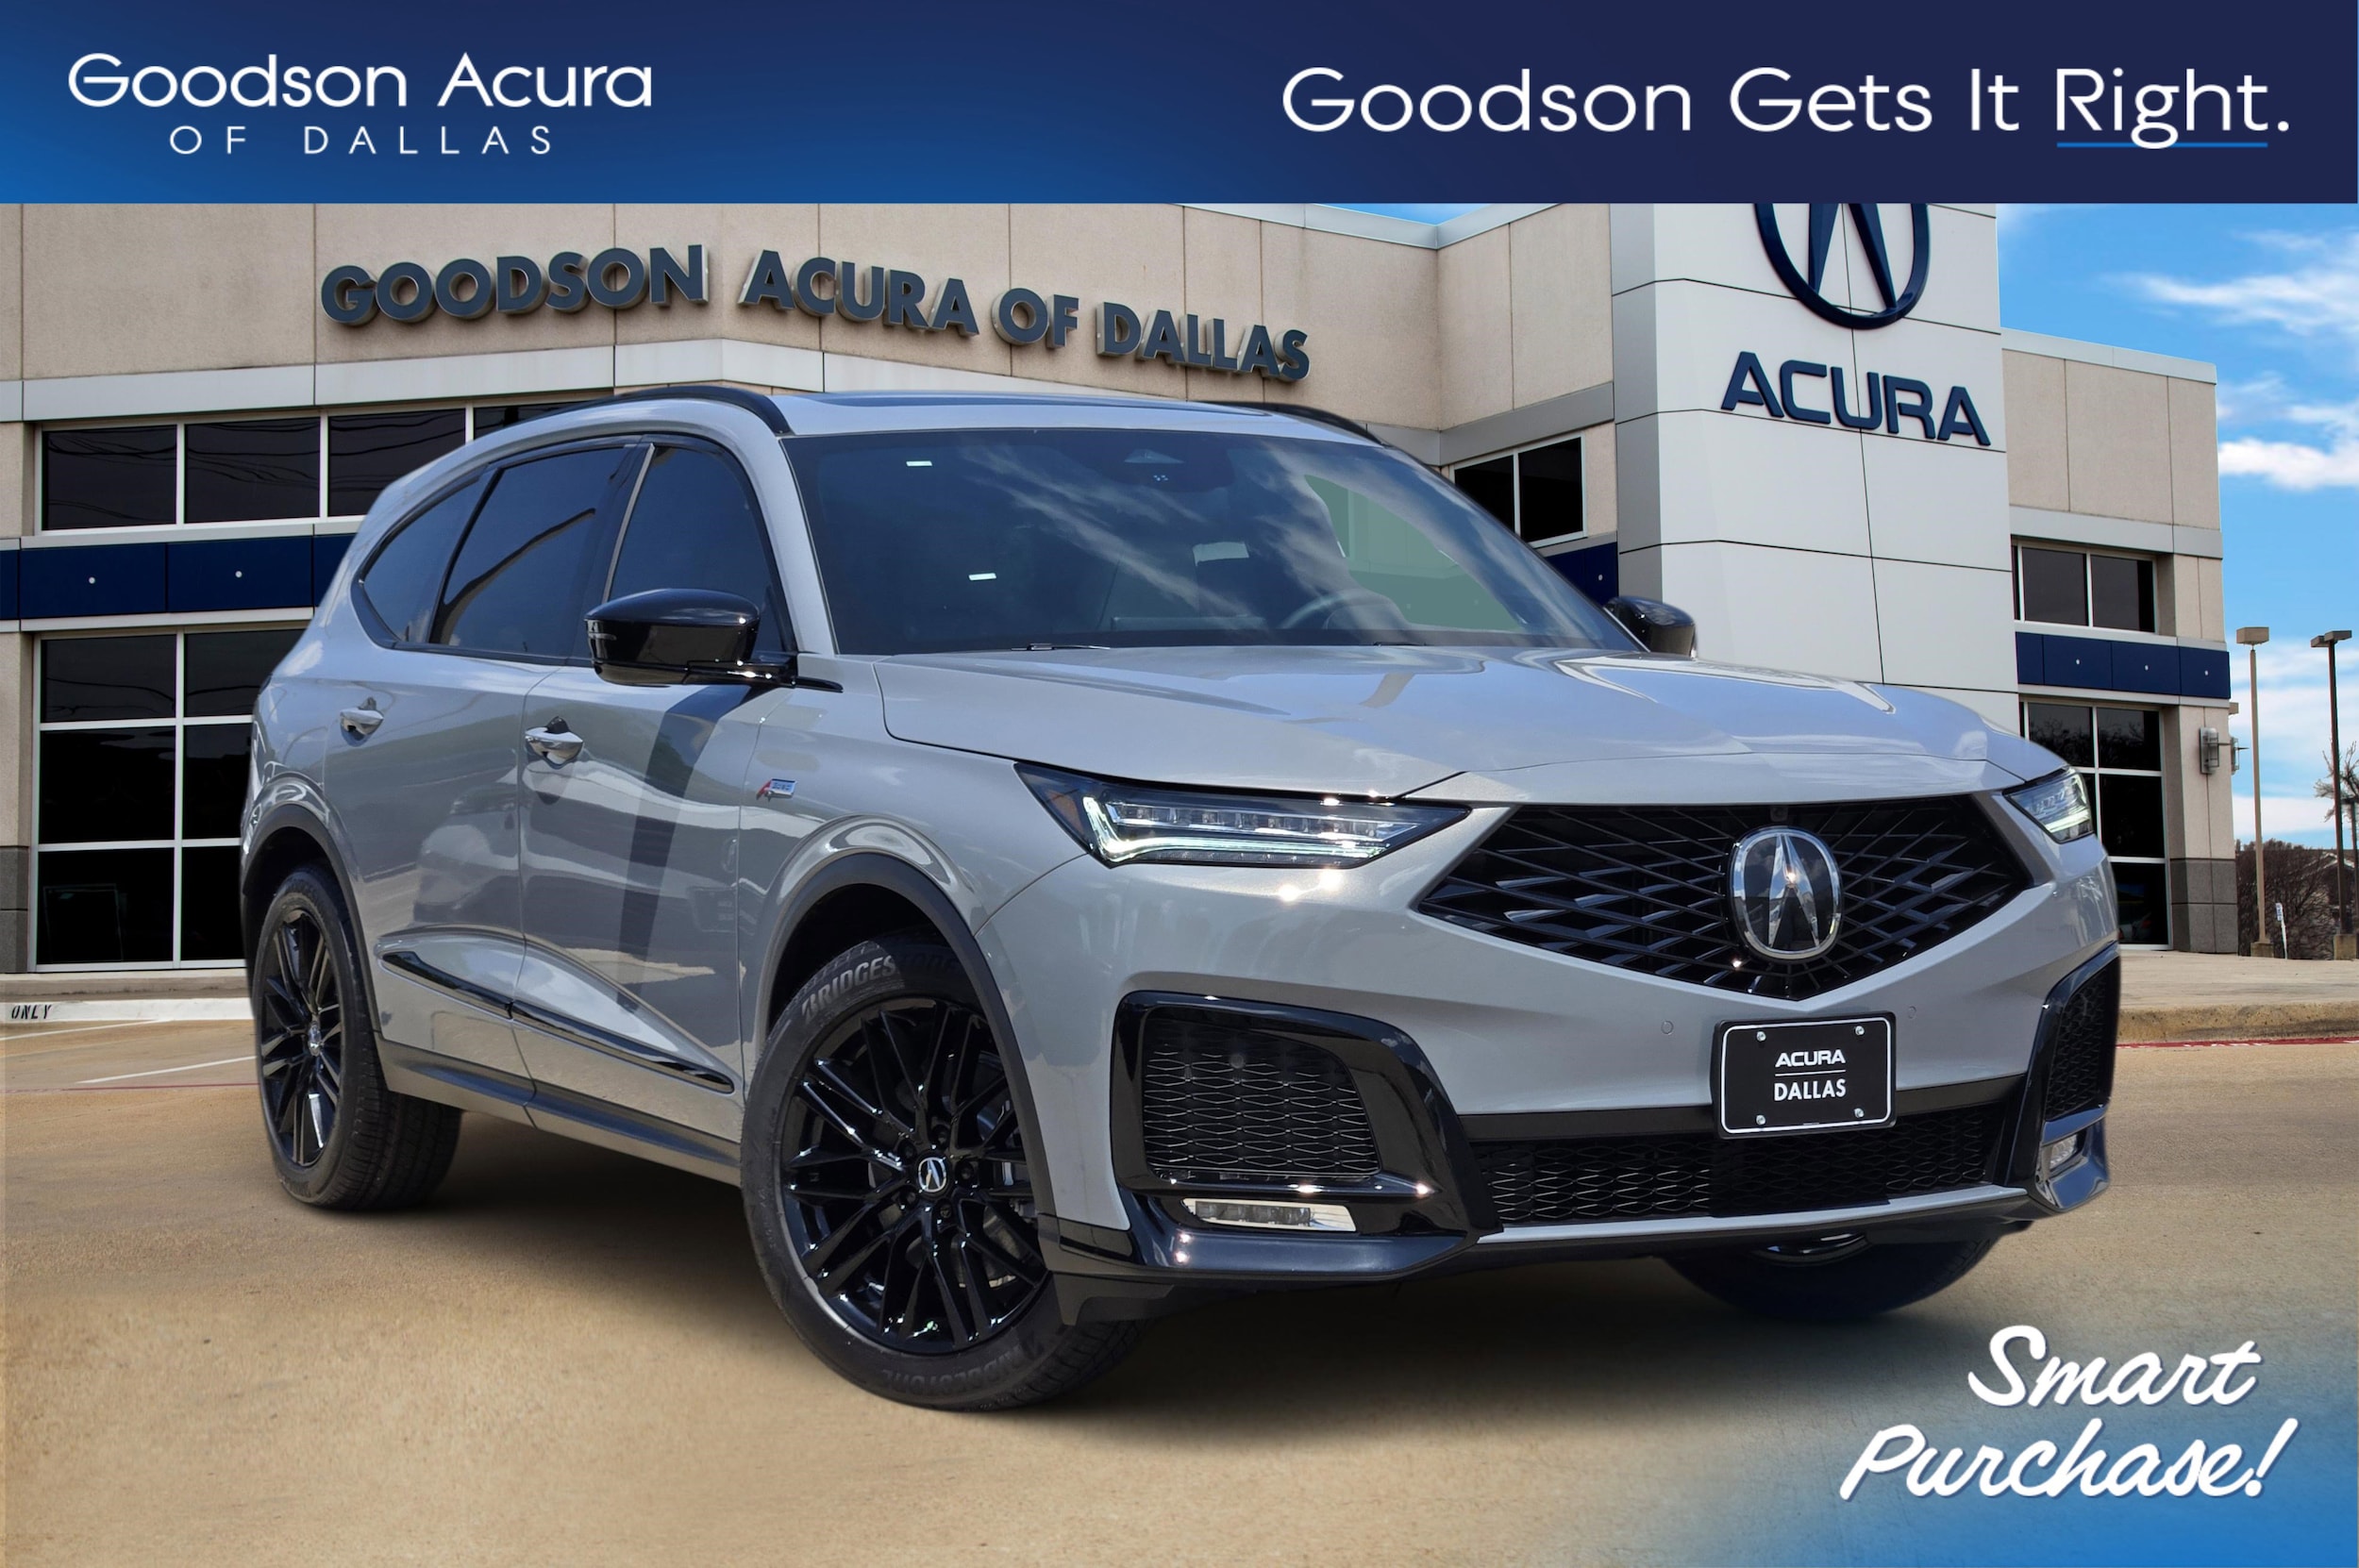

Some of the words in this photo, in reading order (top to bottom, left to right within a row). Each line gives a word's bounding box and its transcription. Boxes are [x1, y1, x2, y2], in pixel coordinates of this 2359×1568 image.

[321, 243, 709, 325] GOODSON
[738, 249, 979, 336] ACURA
[992, 287, 1079, 349] OF
[1096, 301, 1311, 383] DALLAS
[1720, 352, 1991, 446] ACURA
[11, 1004, 52, 1020] ONLY
[1774, 1048, 1847, 1068] ACURA
[1773, 1077, 1847, 1102] DALLAS
